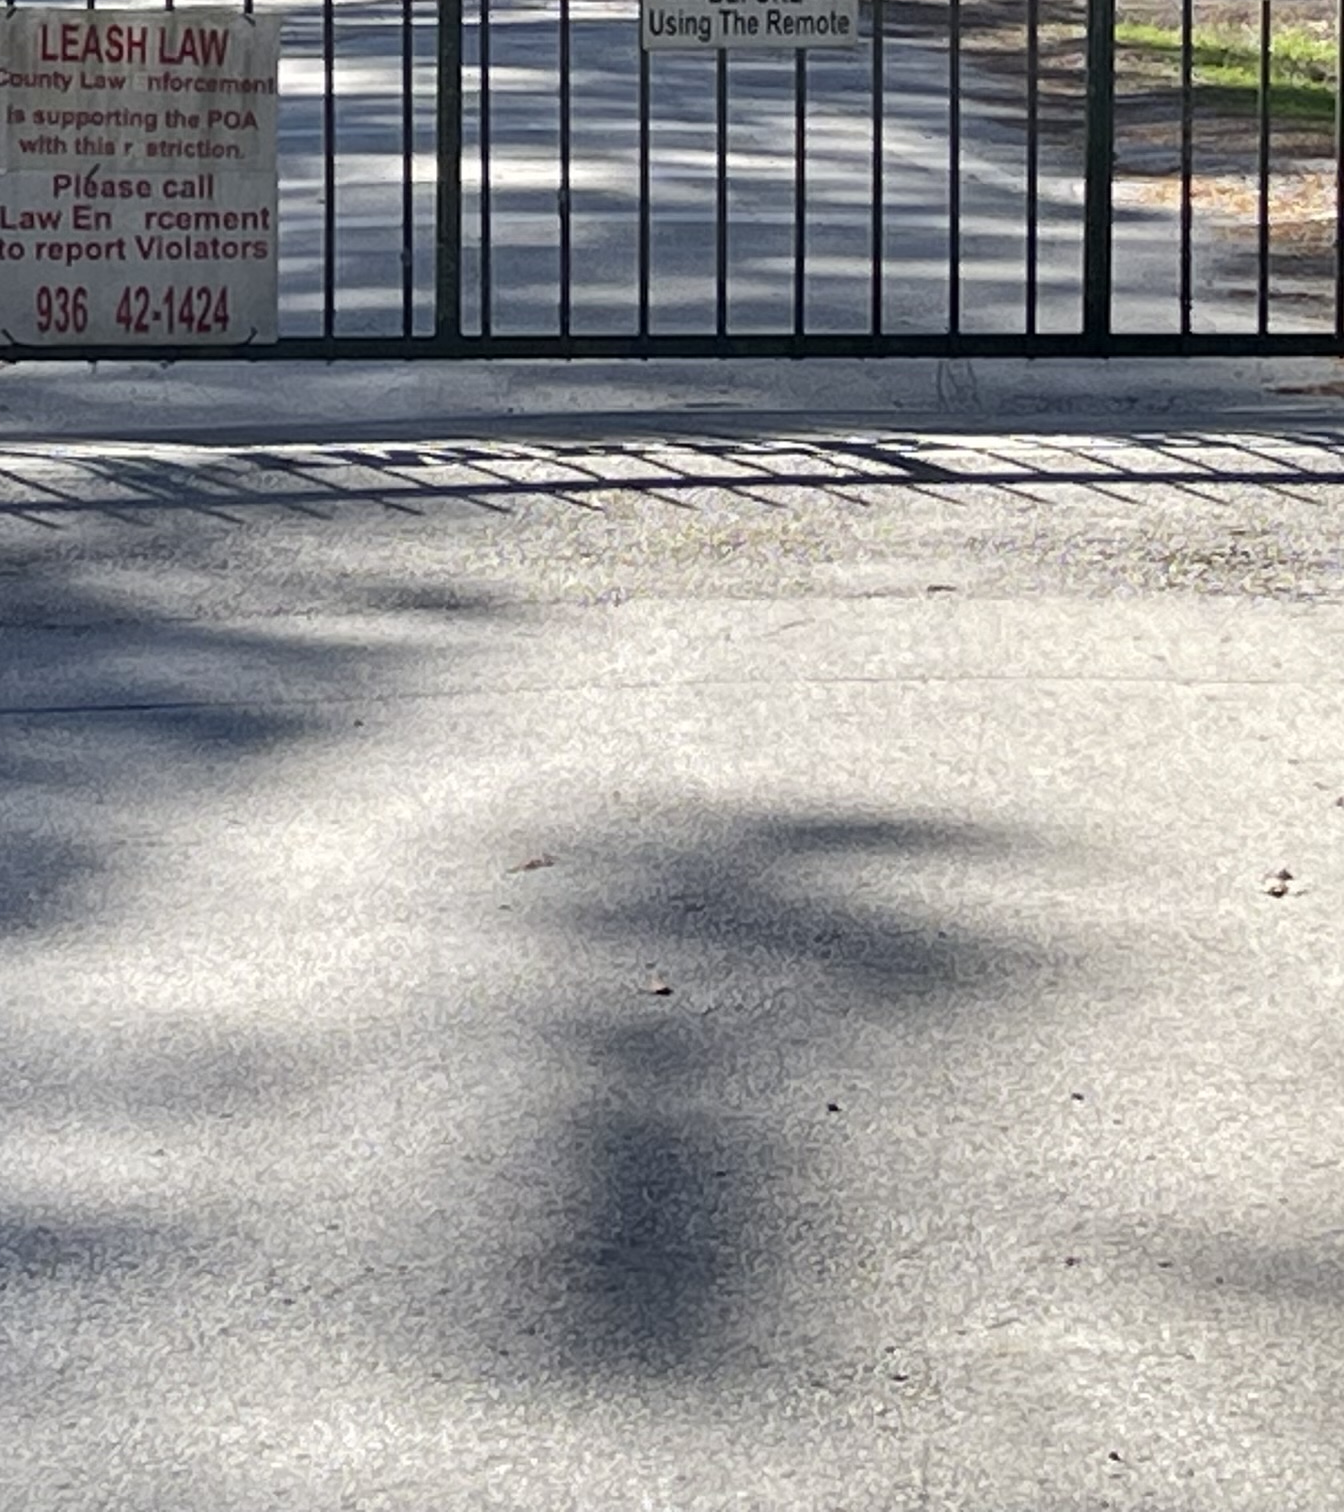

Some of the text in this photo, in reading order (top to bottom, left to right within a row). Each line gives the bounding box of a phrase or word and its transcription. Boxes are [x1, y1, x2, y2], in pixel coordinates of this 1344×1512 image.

[649, 9, 850, 42] Using The Remote
[41, 23, 230, 66] LEASH LAW
[80, 70, 126, 89] Law
[136, 71, 278, 94] nforcement
[33, 107, 156, 132] supporting
[165, 110, 200, 129] the
[208, 110, 259, 131] POA
[19, 136, 245, 160] with this rstriction.
[53, 173, 214, 200] Please call
[0, 205, 269, 231] Law Enrcement
[35, 239, 126, 266] report
[134, 237, 268, 261] Violators
